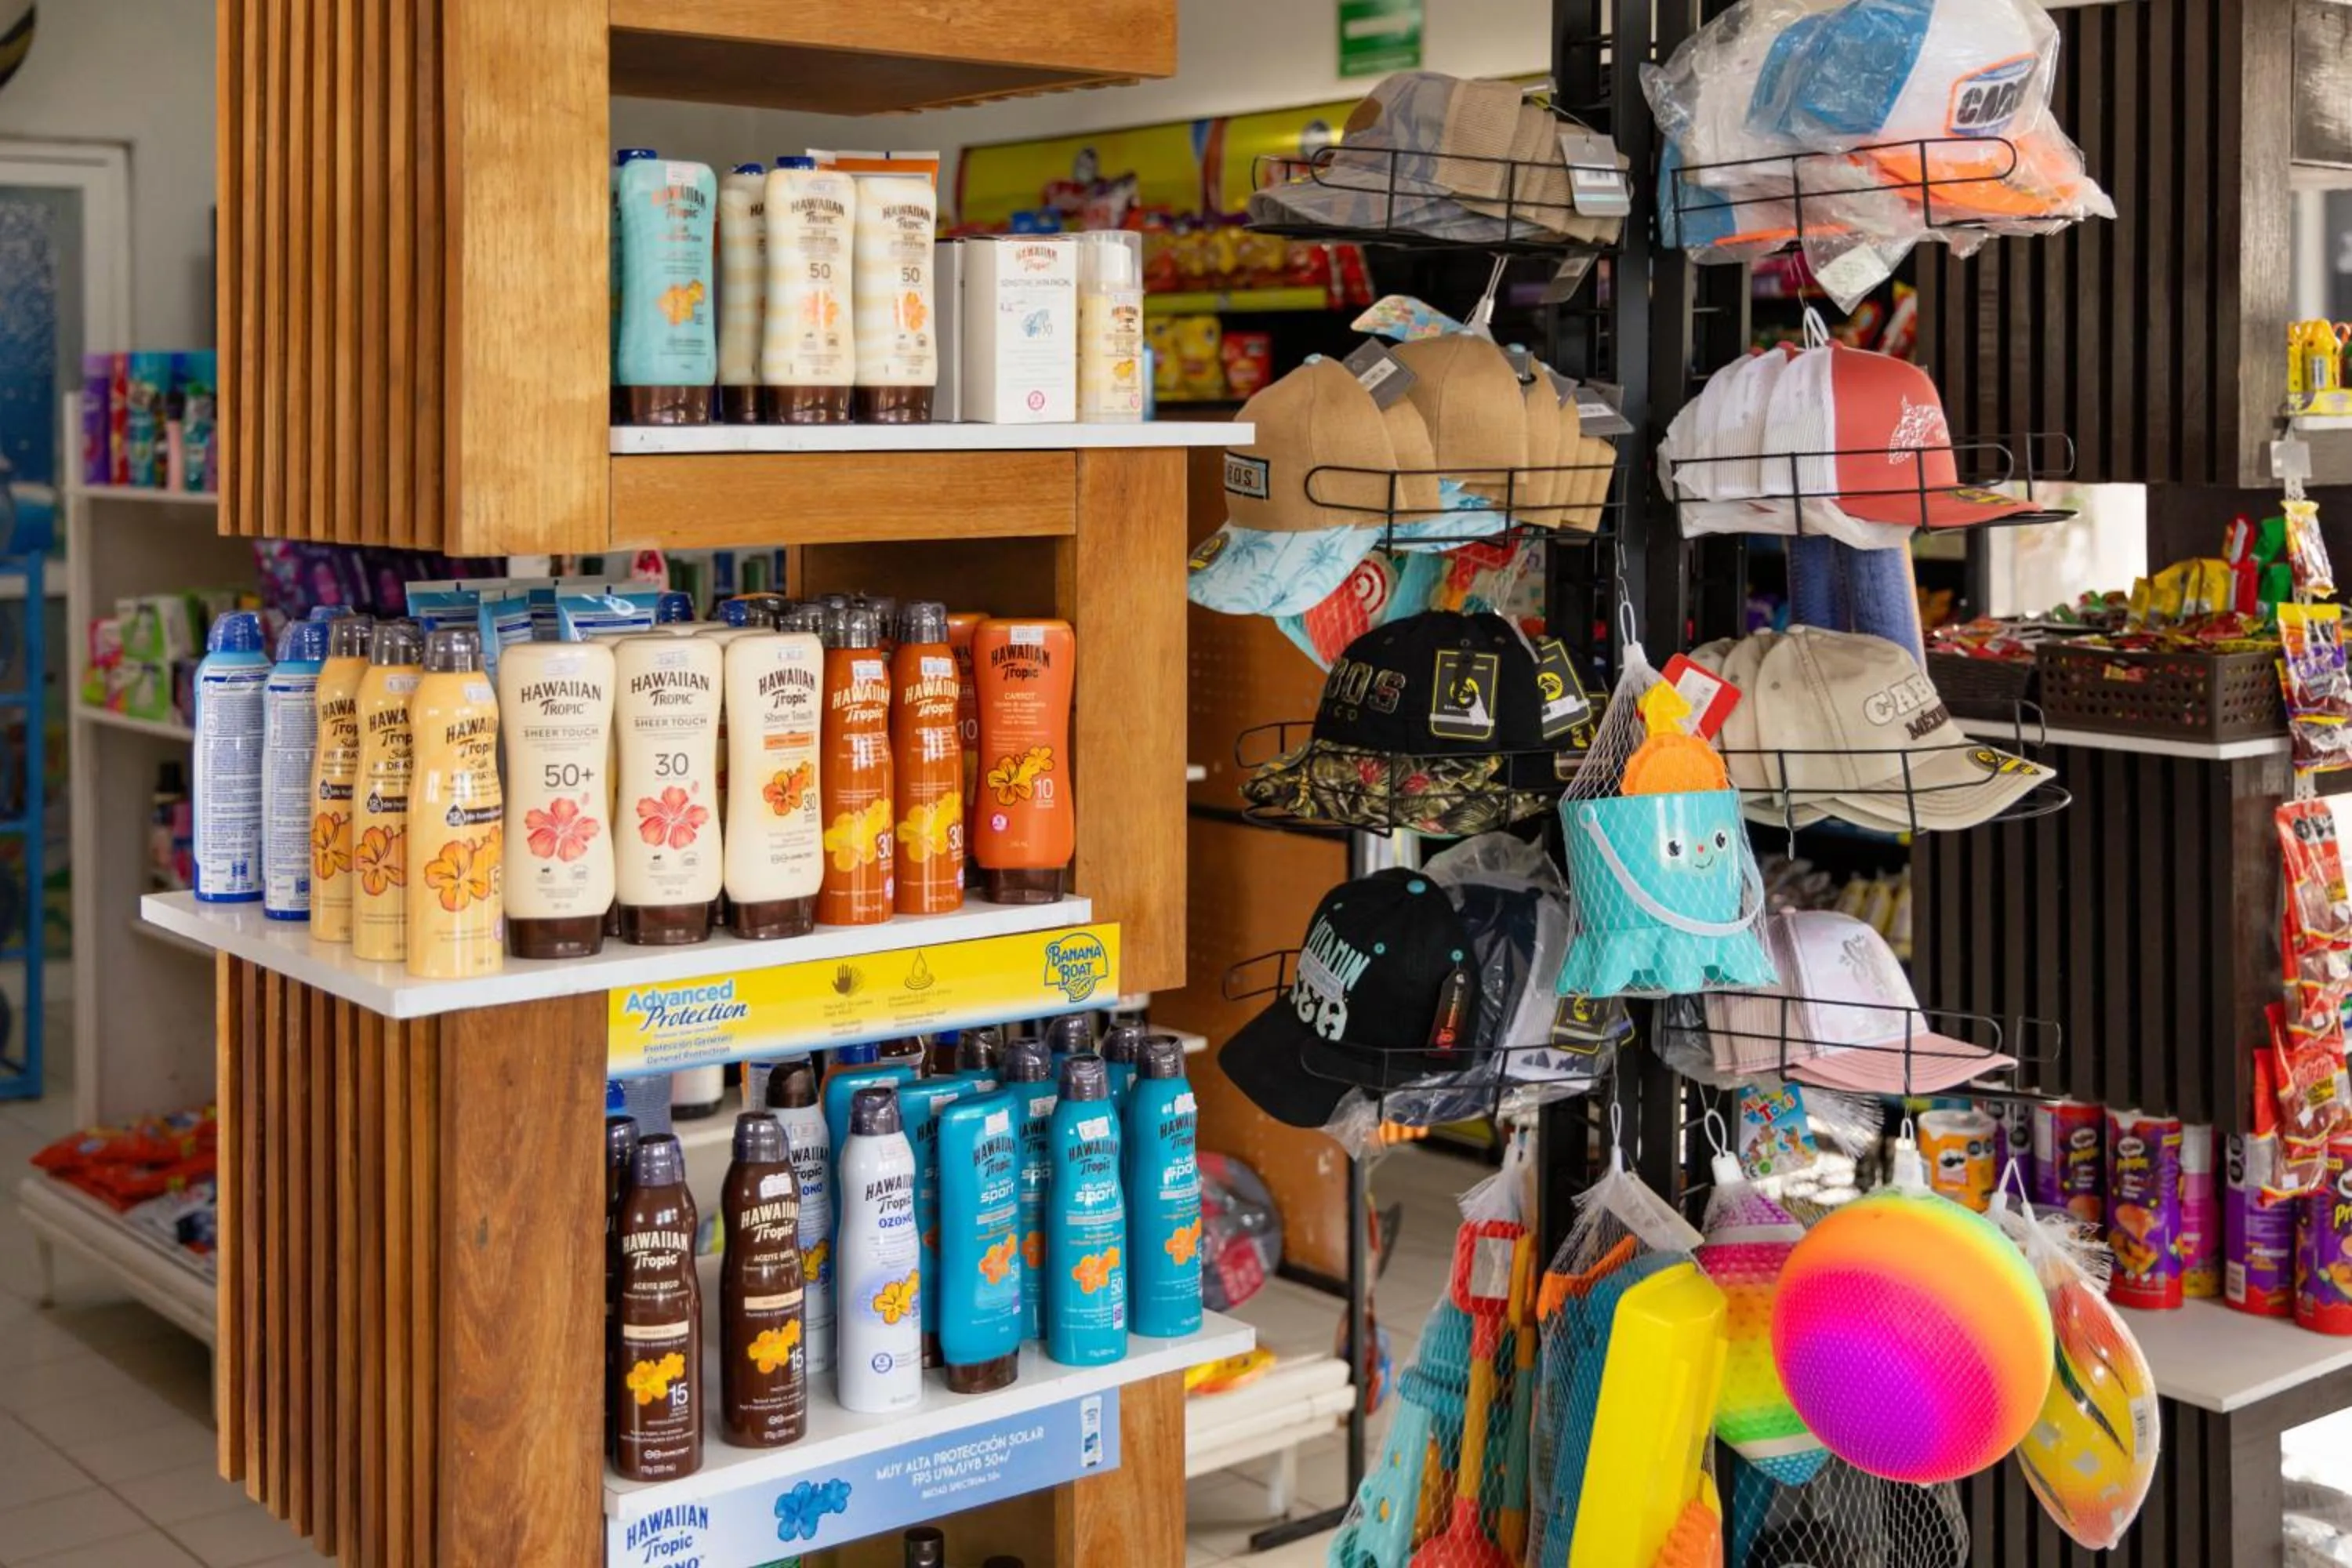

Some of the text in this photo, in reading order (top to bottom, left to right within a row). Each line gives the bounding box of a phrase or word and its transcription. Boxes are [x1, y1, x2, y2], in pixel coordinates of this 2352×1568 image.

[790, 198, 845, 217] HAWAIIAN
[882, 204, 931, 221] HAWAIIAN
[810, 263, 831, 279] 50
[902, 267, 920, 283] 50
[991, 643, 1051, 667] HAWAIIAN
[631, 671, 710, 694] HAWAIIAN
[759, 668, 816, 696] HAWAIIAN
[1001, 662, 1039, 681] Tropic
[521, 681, 602, 703] HAWAIIAN
[771, 688, 807, 709] Tropic
[524, 728, 599, 738] SHEER TOUCH
[634, 717, 708, 728] SHEER TOUCH
[544, 763, 595, 788] 50+
[655, 753, 690, 776] 30
[1034, 779, 1054, 798] 10
[804, 793, 816, 811] 30
[878, 834, 893, 858] 30
[949, 824, 964, 850] 30
[1048, 946, 1102, 967] BANANA
[1058, 961, 1094, 985] BOAT
[626, 979, 734, 1013] Advanced
[639, 1003, 747, 1031] Protection
[877, 1192, 912, 1214] Tropic
[981, 1182, 1014, 1204] sport
[1075, 1184, 1116, 1207] sport
[623, 1231, 688, 1254] HAWAIIAN
[751, 1220, 794, 1243] Tropic
[631, 1250, 678, 1271] Tropic
[1110, 1276, 1124, 1294] 50
[789, 1347, 804, 1370] 15
[668, 1381, 688, 1406] 15
[876, 1426, 1045, 1480] MUY ALTA PROTECCIÓN SOLAR
[912, 1471, 932, 1487] FPS
[935, 1458, 982, 1481] UVA/UVB
[626, 1504, 709, 1552] HAWAIIAN
[641, 1530, 693, 1564] Tropic
